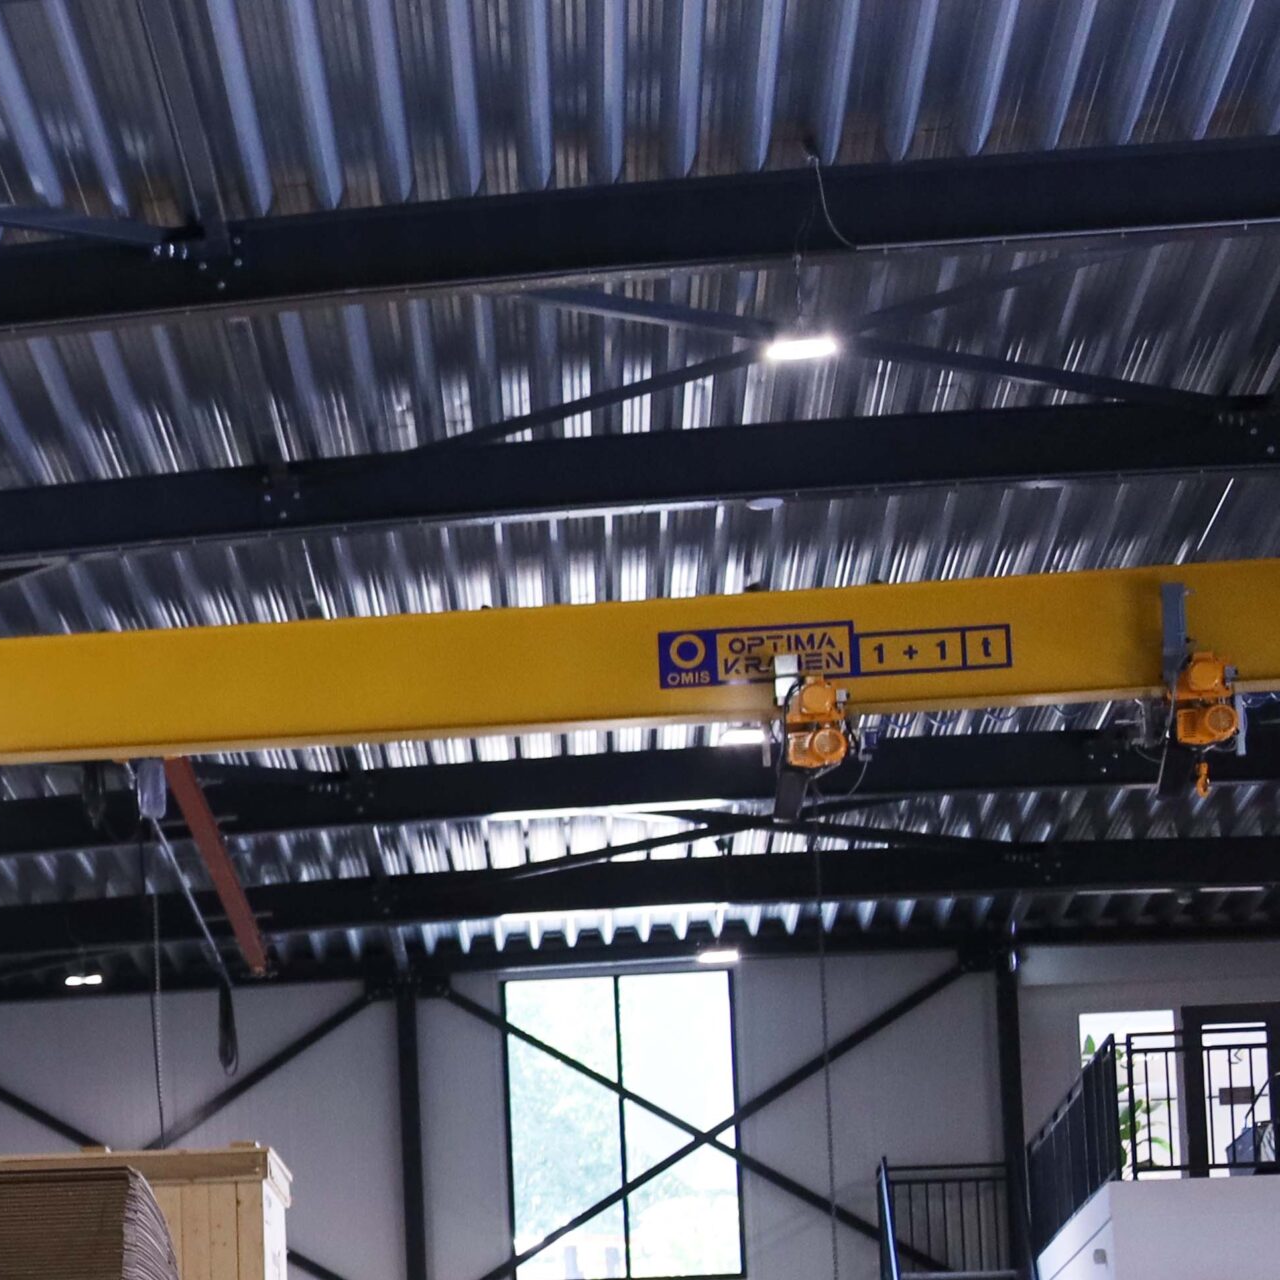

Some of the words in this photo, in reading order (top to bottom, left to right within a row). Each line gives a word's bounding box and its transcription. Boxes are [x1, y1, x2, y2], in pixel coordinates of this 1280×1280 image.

[728, 631, 836, 655] OPTIMA
[981, 636, 992, 658] t
[723, 651, 844, 675] KREN
[666, 671, 710, 686] OMIS
